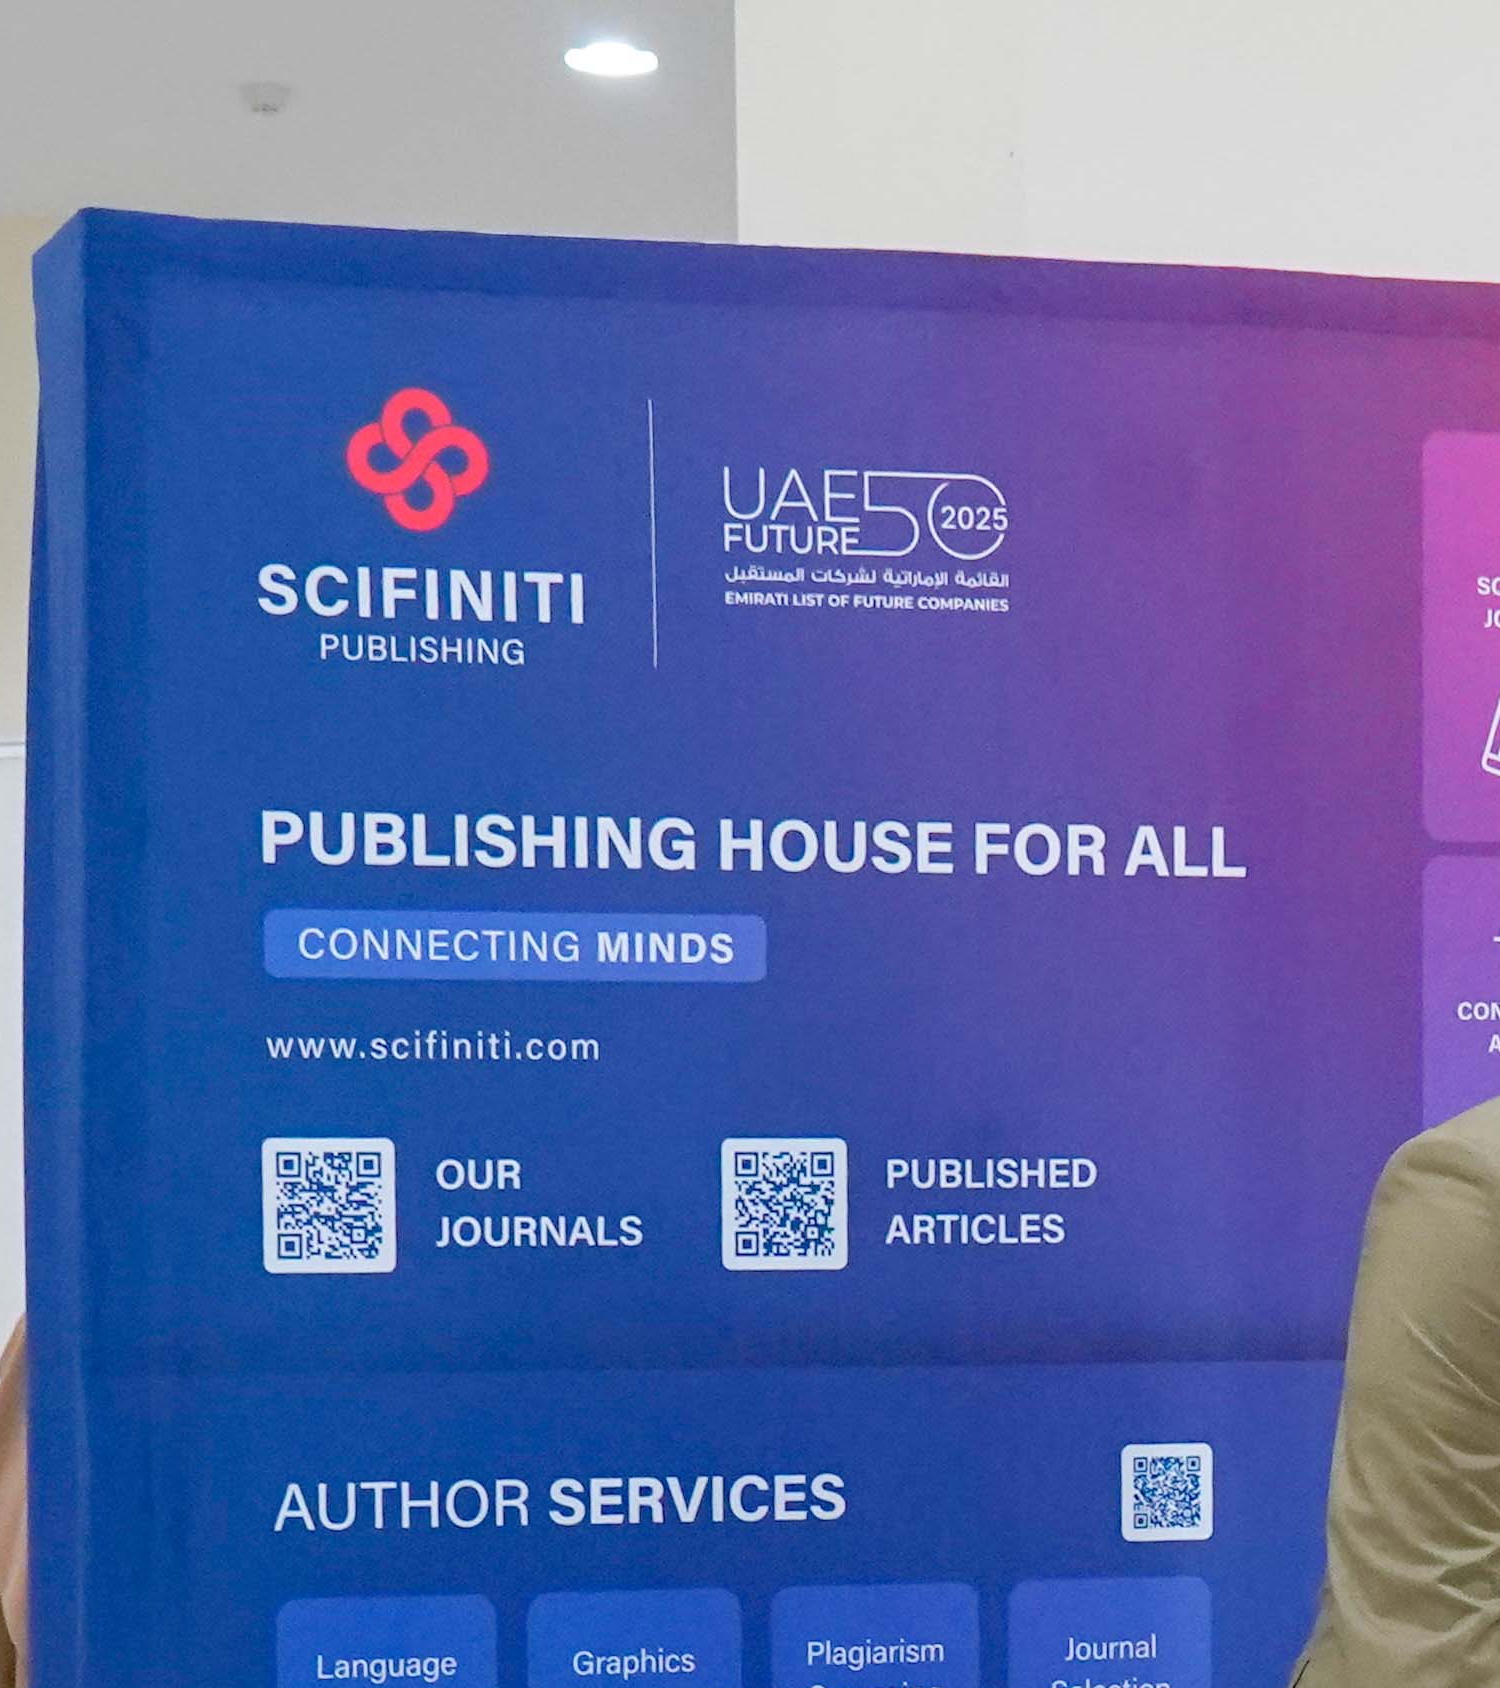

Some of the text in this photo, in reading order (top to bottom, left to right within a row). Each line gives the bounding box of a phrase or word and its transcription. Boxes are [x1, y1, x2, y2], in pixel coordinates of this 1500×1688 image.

[723, 466, 860, 522] UAE
[940, 504, 1009, 533] 2025
[723, 524, 861, 557] FUTURE
[724, 565, 804, 584] المستقبل
[811, 566, 877, 586] لشركات
[955, 570, 1009, 588] القائمة
[257, 563, 586, 625] SCIFINITI
[724, 591, 1009, 612] EMIRATI LIST OF FUTURE COMPANIES
[319, 634, 526, 666] PUBLISHING
[260, 809, 1247, 880] PUBLISHING HOUSE FOR ALL
[298, 926, 735, 965] CONNECTING MINDS
[266, 1031, 601, 1062] www.scifiniti.com
[436, 1158, 521, 1191] OUR
[885, 1157, 1097, 1190] PUBLISHED
[435, 1214, 643, 1249] JOURNALS
[884, 1213, 1065, 1246] ARTICLES
[274, 1473, 846, 1532] AUTHOR SERVICES
[572, 1647, 696, 1679] Graphics
[806, 1636, 945, 1671] Plagiarism
[1063, 1633, 1157, 1663] Journal
[316, 1651, 457, 1685] Language
